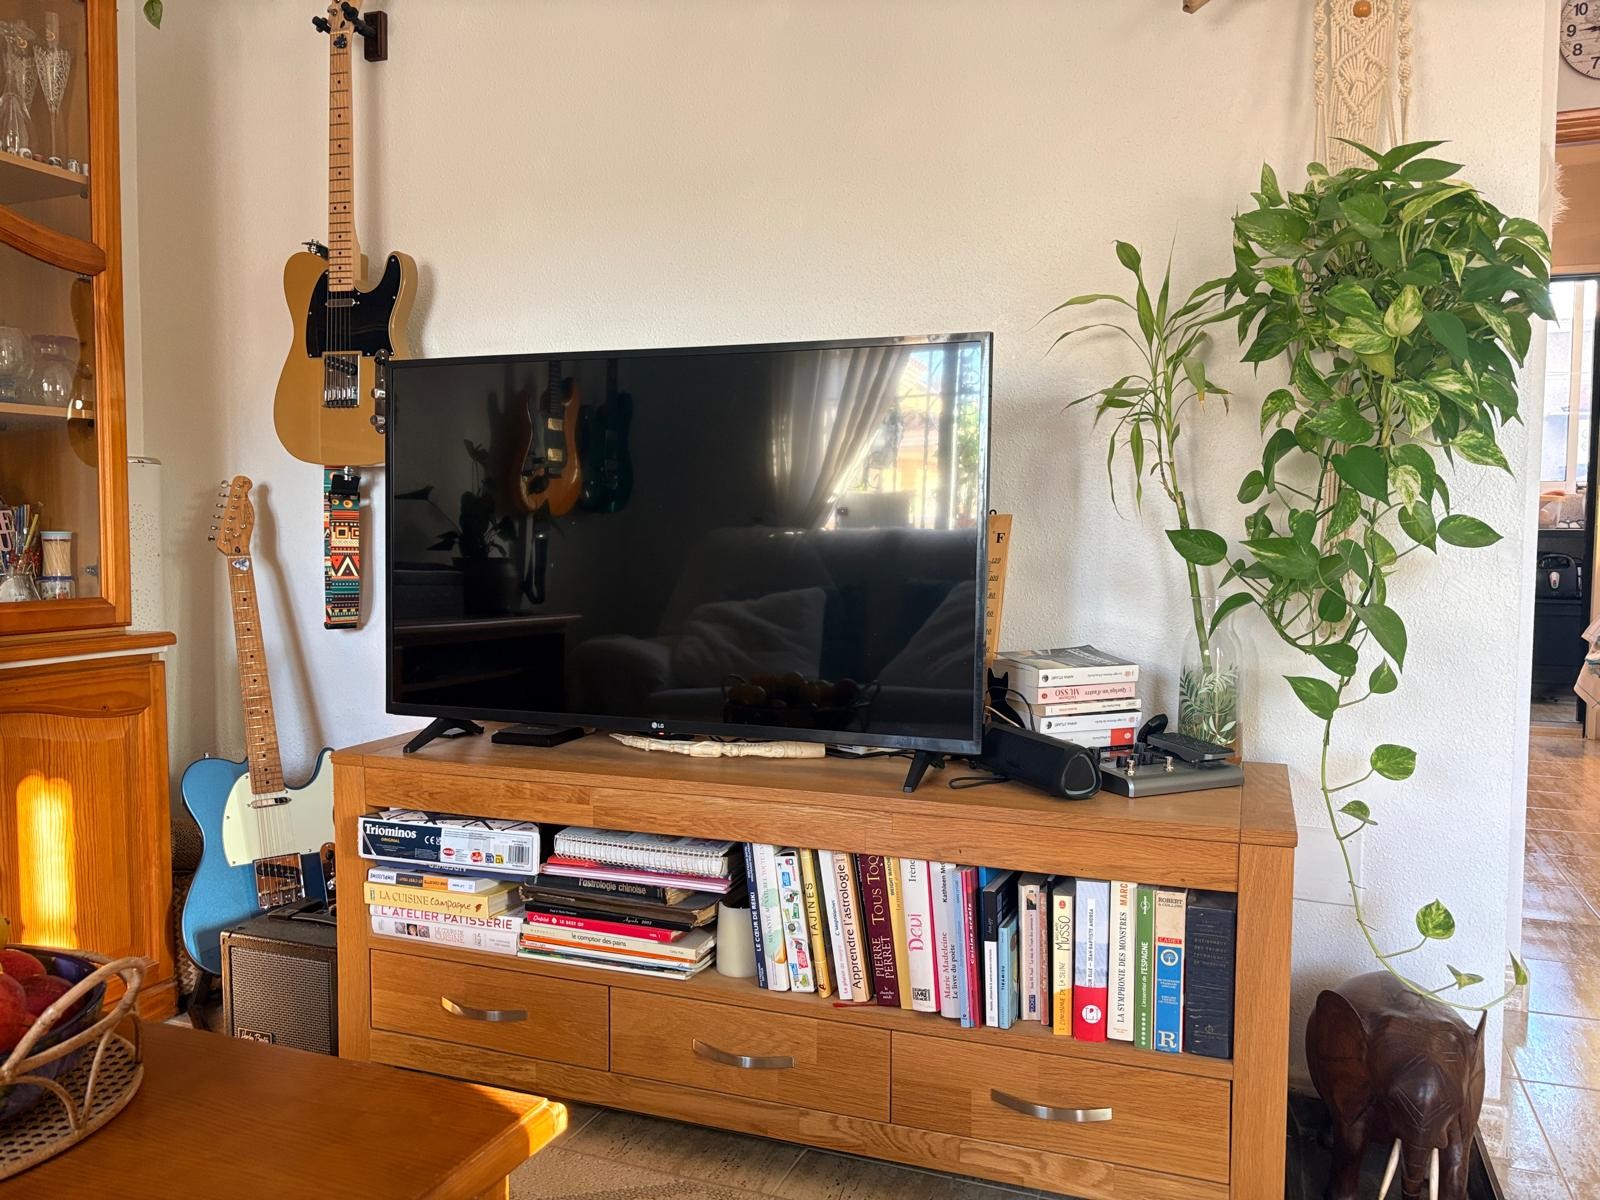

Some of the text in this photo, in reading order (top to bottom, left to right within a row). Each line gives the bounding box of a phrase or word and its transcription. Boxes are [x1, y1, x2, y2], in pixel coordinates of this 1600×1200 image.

[1574, 2, 1588, 16] 10
[1566, 24, 1577, 37] 9
[1572, 43, 1583, 56] 8
[1591, 56, 1600, 69] 7
[1055, 688, 1080, 697] MUSSO
[364, 823, 417, 839] Triominos
[578, 878, 647, 895] l'astrologie chinoise
[1120, 883, 1128, 906] MARC
[379, 890, 471, 913] LA CUISINE Campagne
[806, 882, 819, 936] TAJINES
[871, 888, 885, 926] TOUS
[381, 905, 439, 921] L'ATELIER
[752, 911, 759, 920] DE
[837, 864, 863, 989] Apprendre l'astrologie
[1055, 915, 1071, 951] MUSSO
[1119, 911, 1127, 951] MONSTRES
[571, 931, 577, 939] le
[612, 940, 627, 949] pains
[755, 943, 761, 951] LE
[872, 938, 885, 977] PIERRE
[880, 936, 895, 979] PERRET
[941, 932, 949, 973] Madeleine
[1118, 952, 1126, 967] DES
[950, 964, 957, 974] du
[1117, 969, 1126, 1012] SYMPHONIE
[1116, 1013, 1124, 1023] LA
[1157, 1030, 1177, 1048] R
